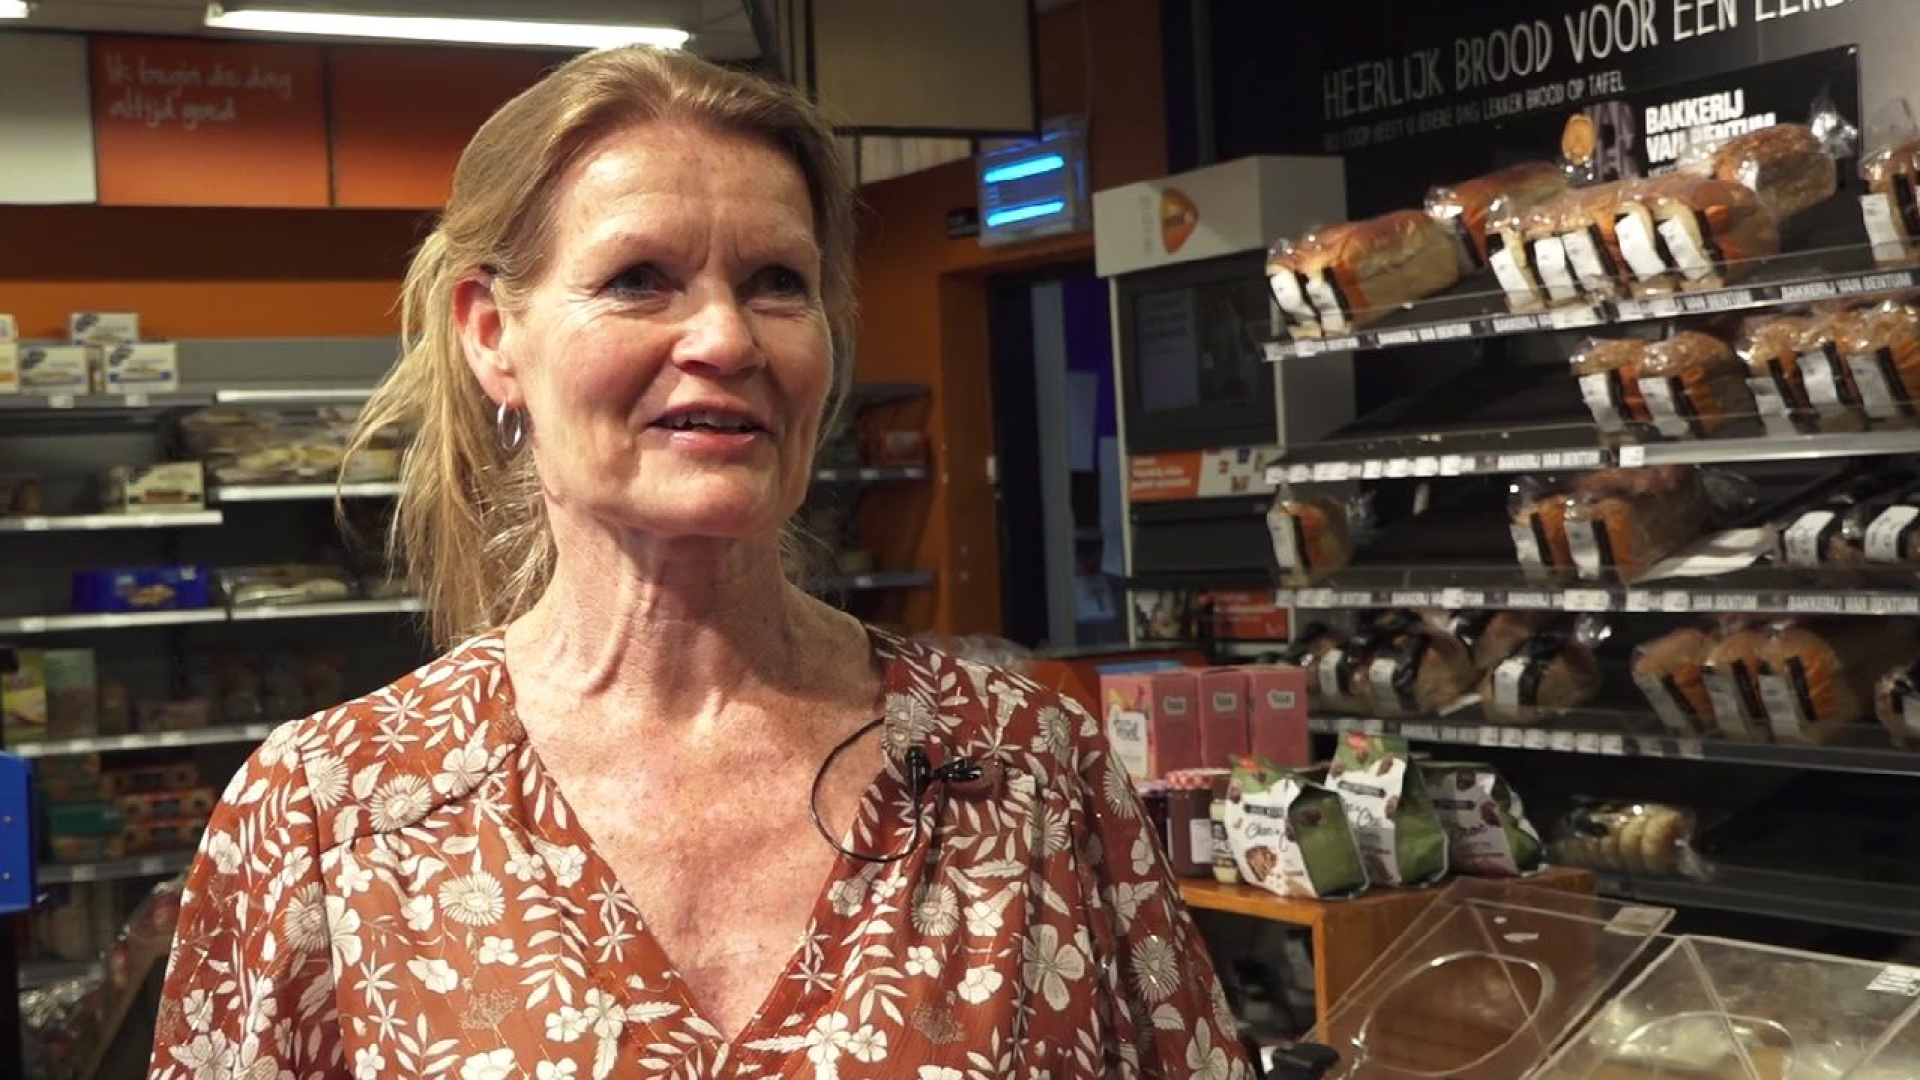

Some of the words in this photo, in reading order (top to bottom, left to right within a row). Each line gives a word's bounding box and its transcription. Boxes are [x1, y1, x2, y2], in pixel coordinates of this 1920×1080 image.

[138, 55, 201, 97] begin
[244, 65, 292, 100] dag
[1323, 48, 1444, 121] HEERLIJK
[1454, 20, 1553, 90] BROOD
[1564, 0, 1658, 64] VOOR
[1673, 0, 1738, 42] EEN
[109, 87, 177, 129] altijd
[182, 96, 238, 131] goed
[1482, 93, 1523, 120] LEKKER
[1524, 83, 1564, 109] BROOD
[1566, 80, 1584, 101] OP
[1588, 71, 1626, 96] TAFEL
[1645, 88, 1744, 134] BAKKERIJ
